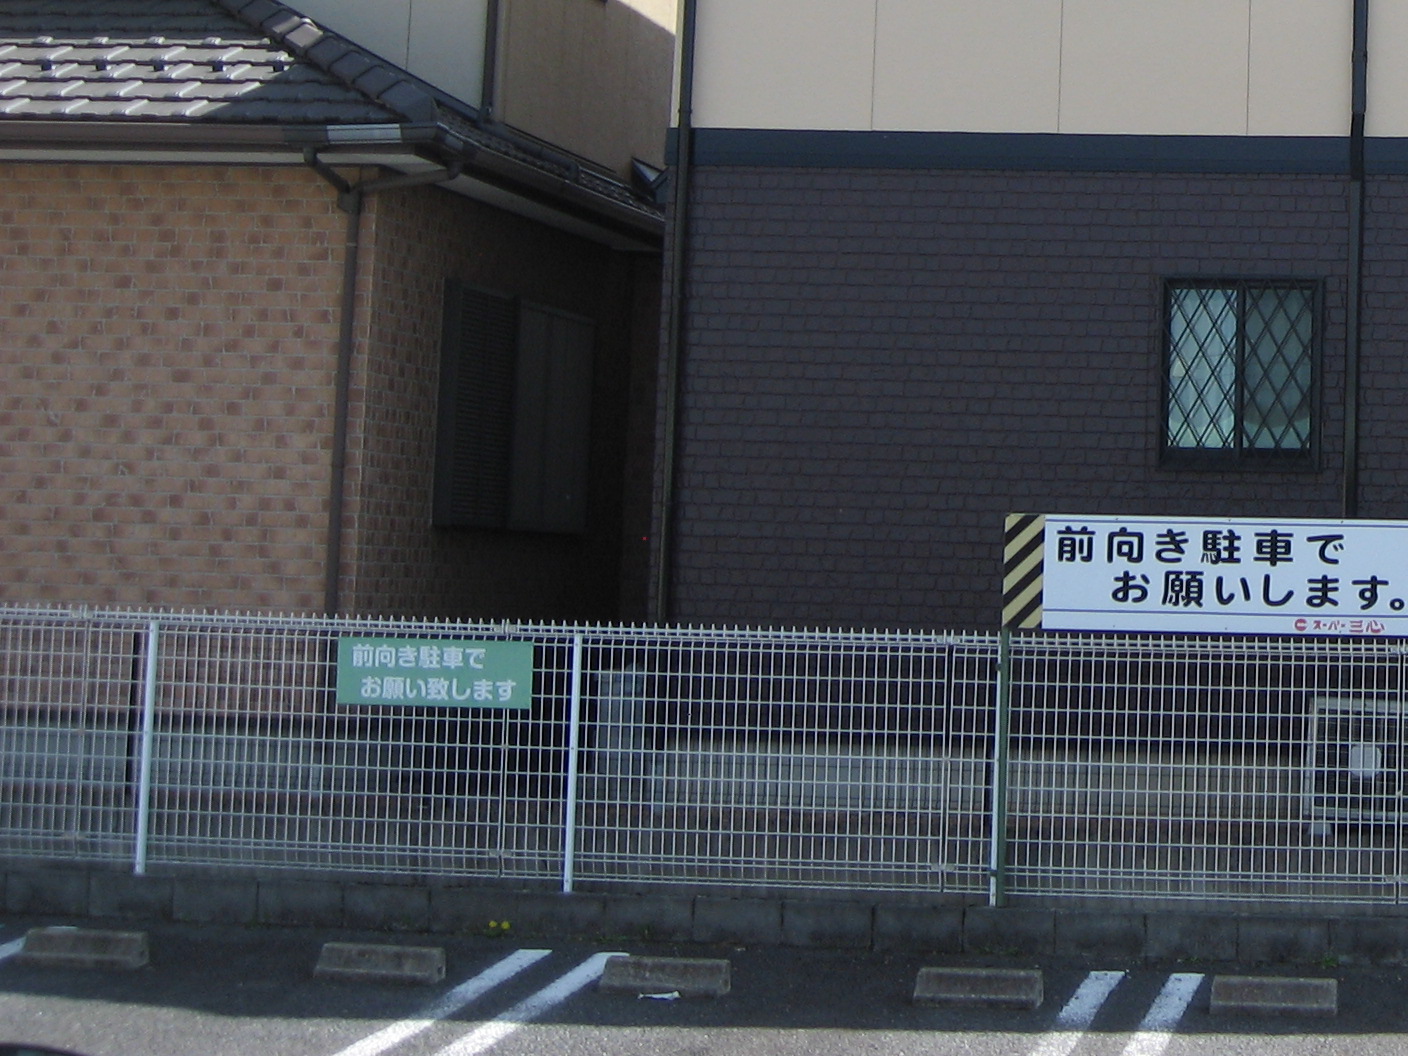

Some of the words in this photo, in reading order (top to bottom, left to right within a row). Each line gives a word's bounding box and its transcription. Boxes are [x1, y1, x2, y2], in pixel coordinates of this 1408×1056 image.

[1056, 526, 1345, 566] 前向き駐車で
[1111, 570, 1405, 611] お願いします。
[352, 644, 486, 669] 前向き駐車で
[360, 676, 516, 702] お願い致します
